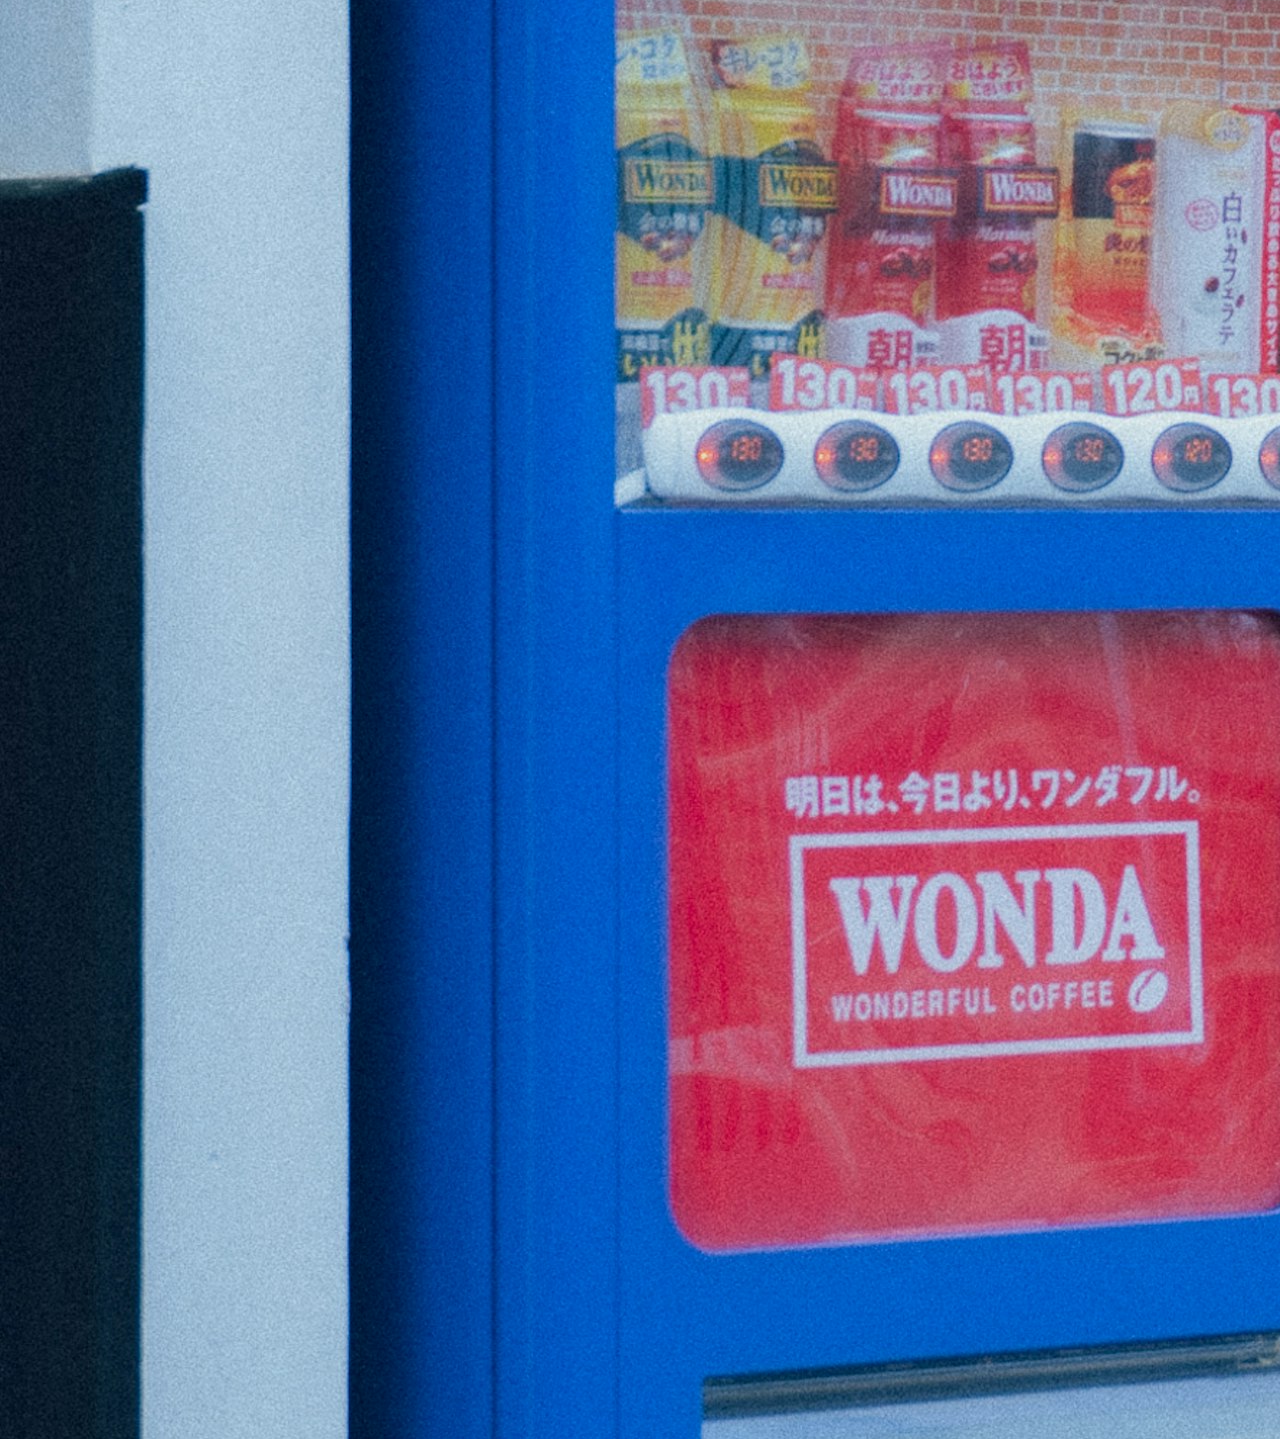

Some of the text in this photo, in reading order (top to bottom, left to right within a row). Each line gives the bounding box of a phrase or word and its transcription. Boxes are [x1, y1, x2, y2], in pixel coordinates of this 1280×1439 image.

[885, 175, 955, 208] WONDA
[991, 172, 1055, 204] WONDA
[1219, 192, 1243, 346] 白いカフェラテ
[1107, 364, 1200, 414] 120円
[730, 435, 763, 462] 130
[962, 436, 993, 462] 130
[784, 765, 1202, 819] 明日は、今日より、ワンダフル。
[828, 863, 1167, 977] WONDA
[829, 979, 1115, 1023] WONDERFUL COFFEE
